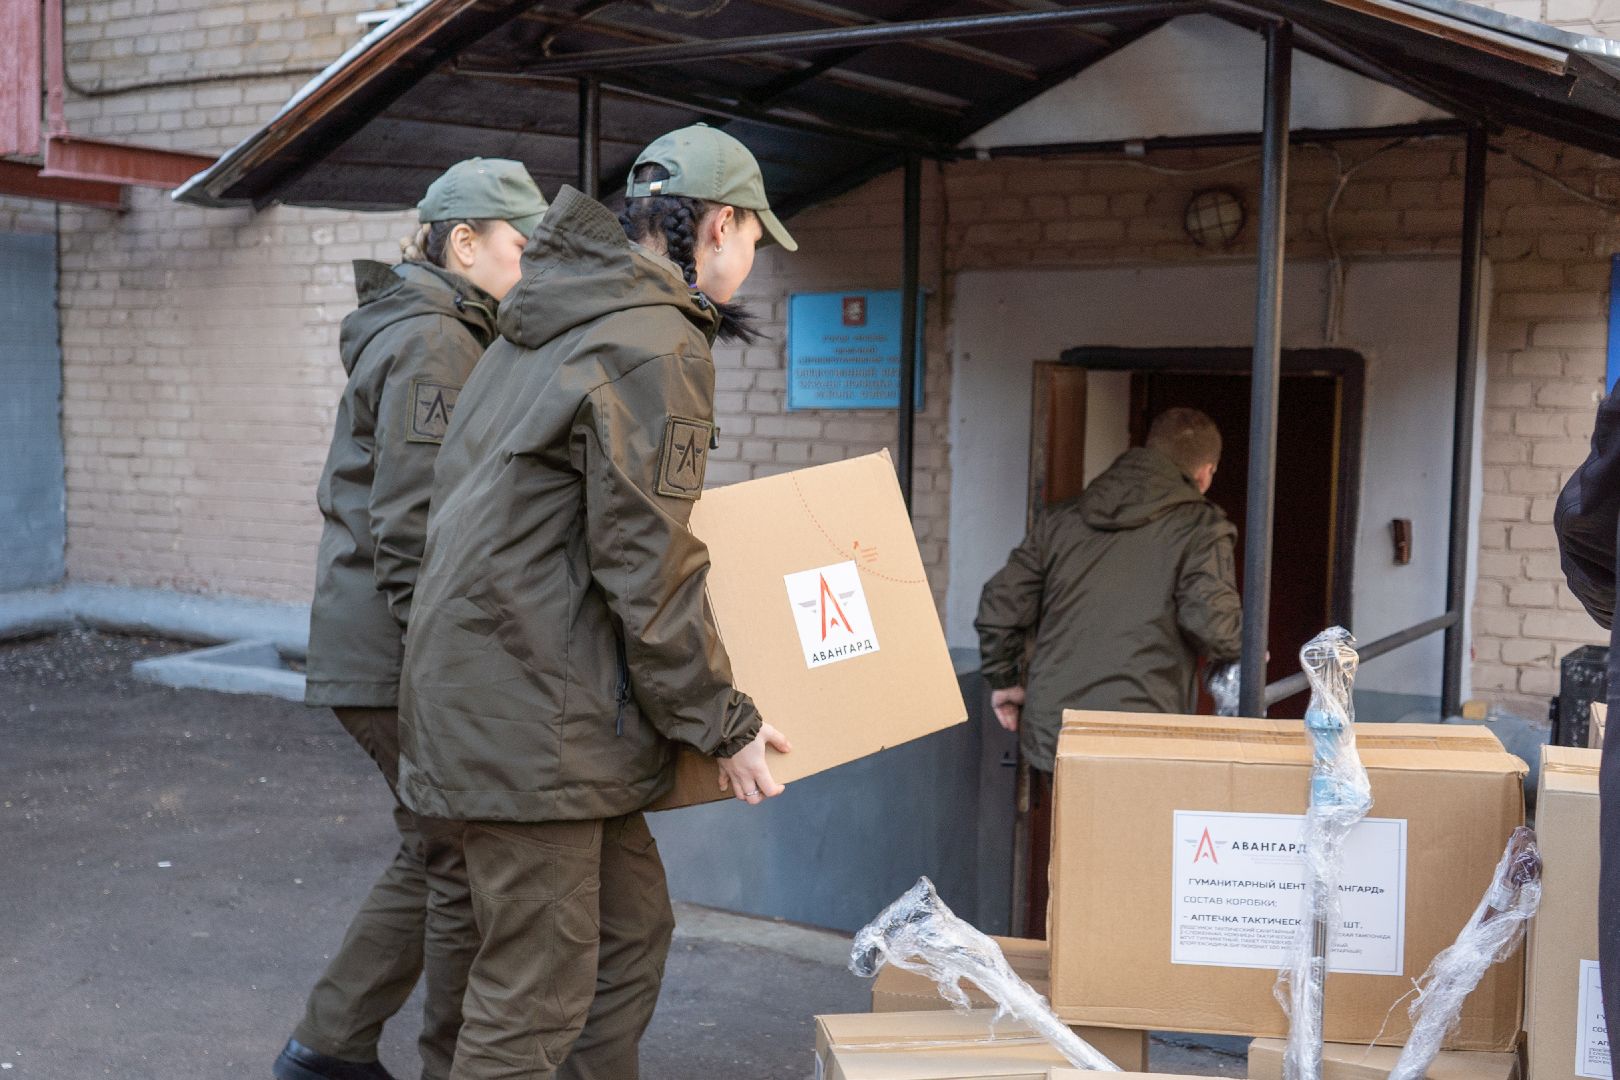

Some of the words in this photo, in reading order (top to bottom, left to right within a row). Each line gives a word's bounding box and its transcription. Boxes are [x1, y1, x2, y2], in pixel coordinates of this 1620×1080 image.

[812, 639, 873, 664] АВАНГАРД
[1188, 878, 1276, 889] ГУМАНИТАРНЫЙ
[1279, 882, 1307, 891] ЦЕНТ
[1183, 896, 1223, 905] СОСТАВ
[1191, 914, 1239, 923] АПТЕЧКА
[1241, 916, 1302, 926] ТАКТИЧЕСК
